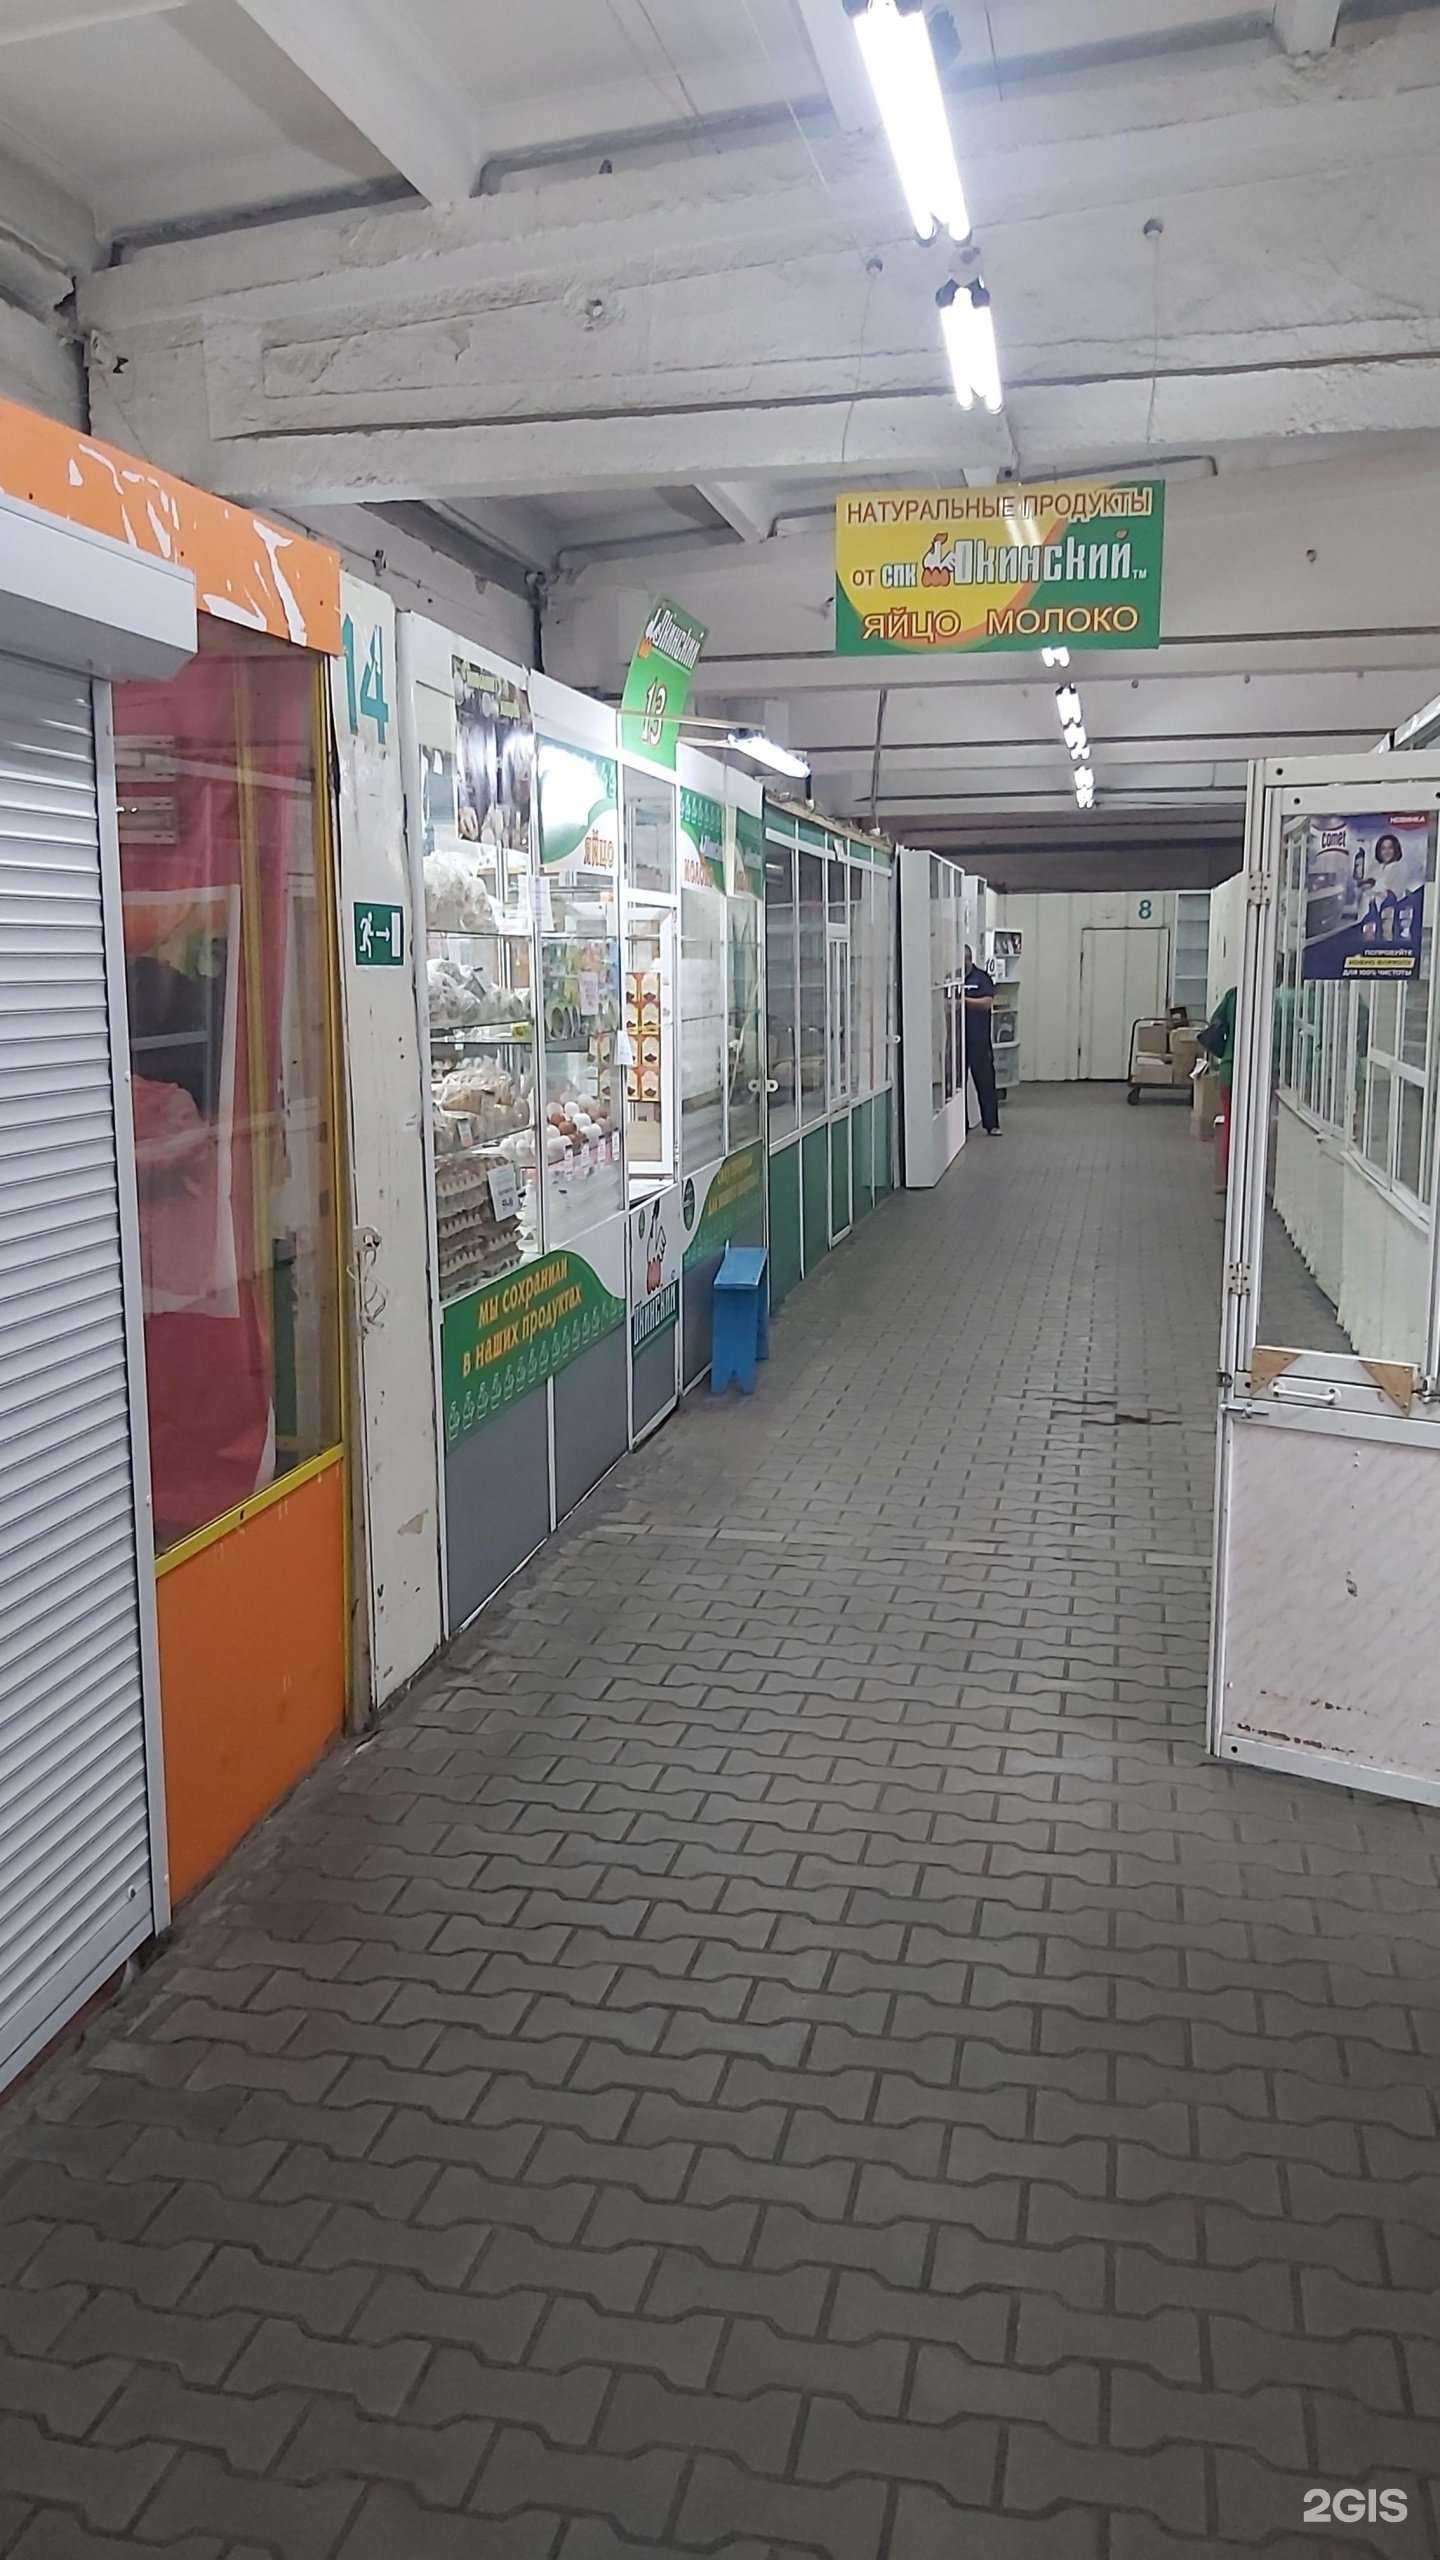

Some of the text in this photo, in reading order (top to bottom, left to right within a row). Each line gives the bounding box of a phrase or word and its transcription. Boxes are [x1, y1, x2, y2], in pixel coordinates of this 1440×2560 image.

[847, 488, 1151, 525] НАТУРАЛЬНЫЕ ПРОДУКТЫ
[852, 568, 875, 588] ОТ
[880, 562, 918, 588] СПК
[952, 529, 1133, 585] Окинский
[862, 606, 1140, 644] ЯЙЦО МОЛОКО
[342, 613, 389, 746] 14
[640, 679, 668, 747] 13
[1139, 899, 1152, 920] 8
